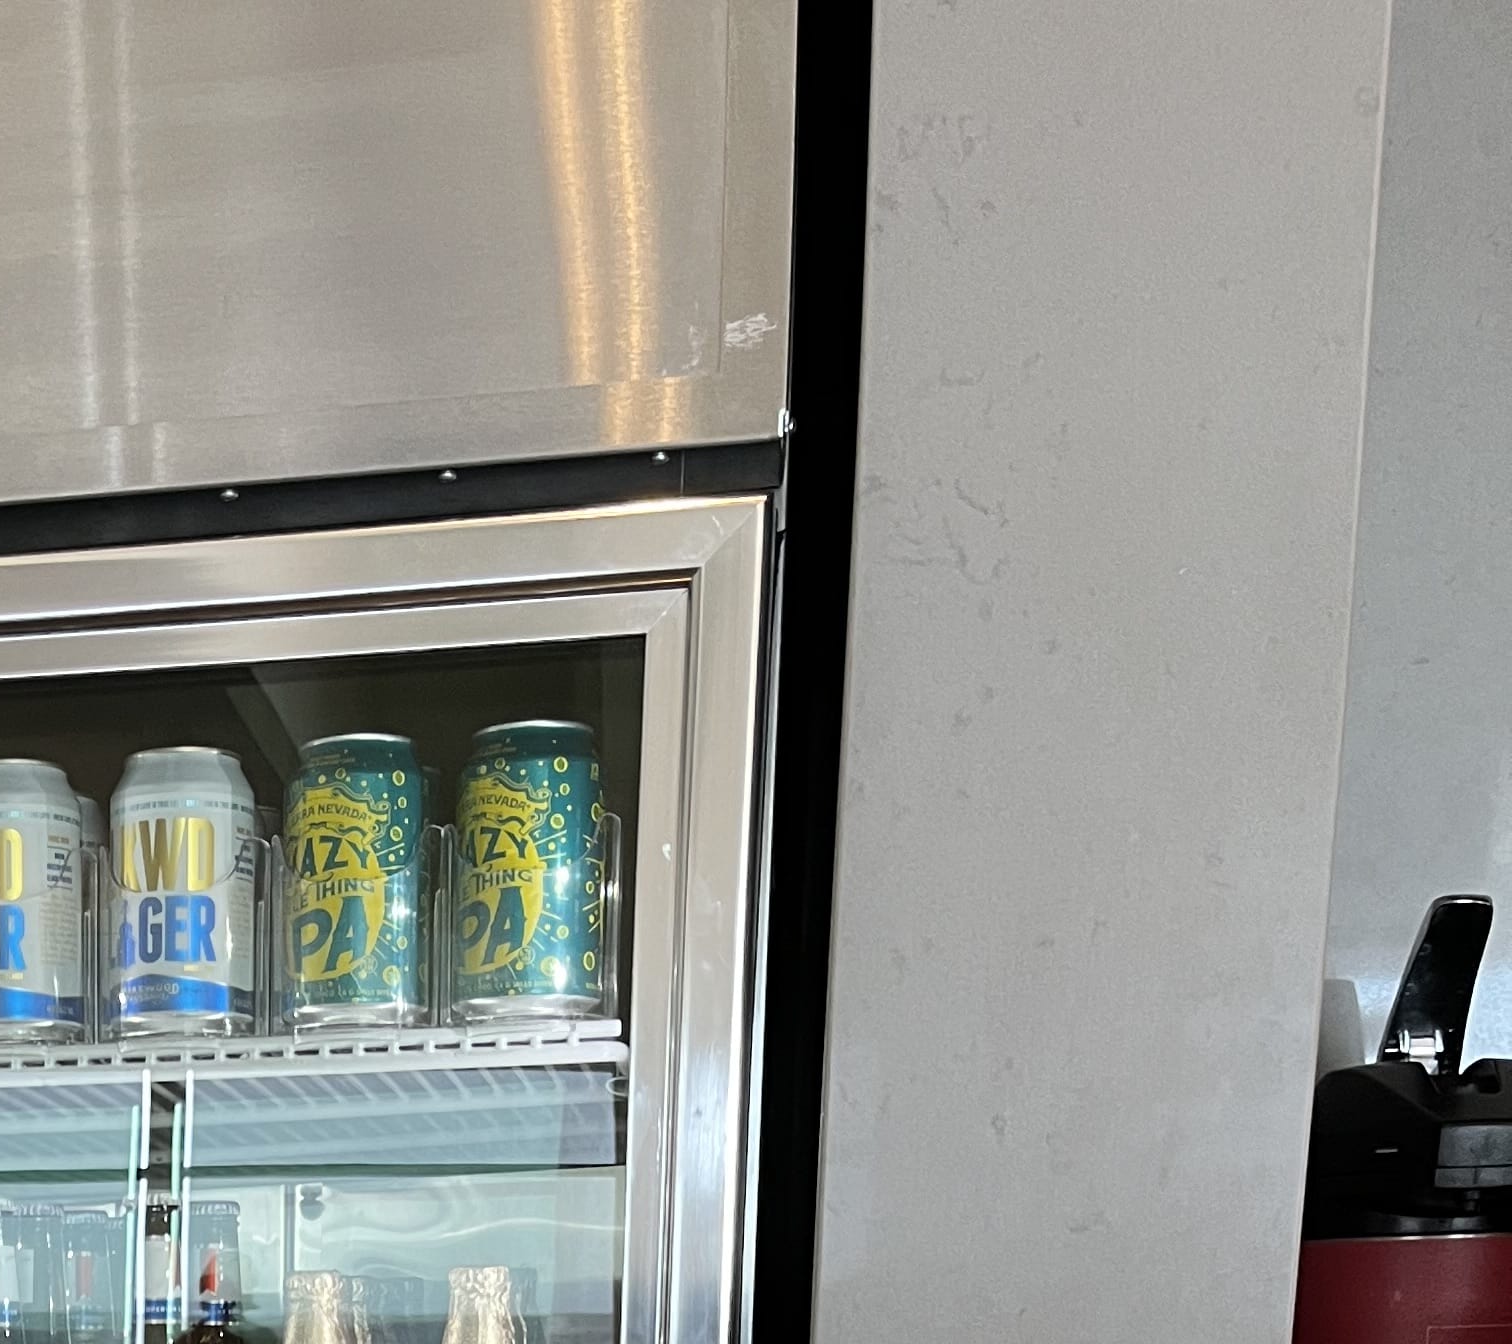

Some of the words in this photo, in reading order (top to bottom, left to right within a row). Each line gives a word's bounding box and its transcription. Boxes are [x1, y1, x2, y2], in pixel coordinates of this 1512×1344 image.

[317, 803, 368, 823] NEVADA
[315, 877, 376, 901] THING
[473, 868, 534, 895] THING
